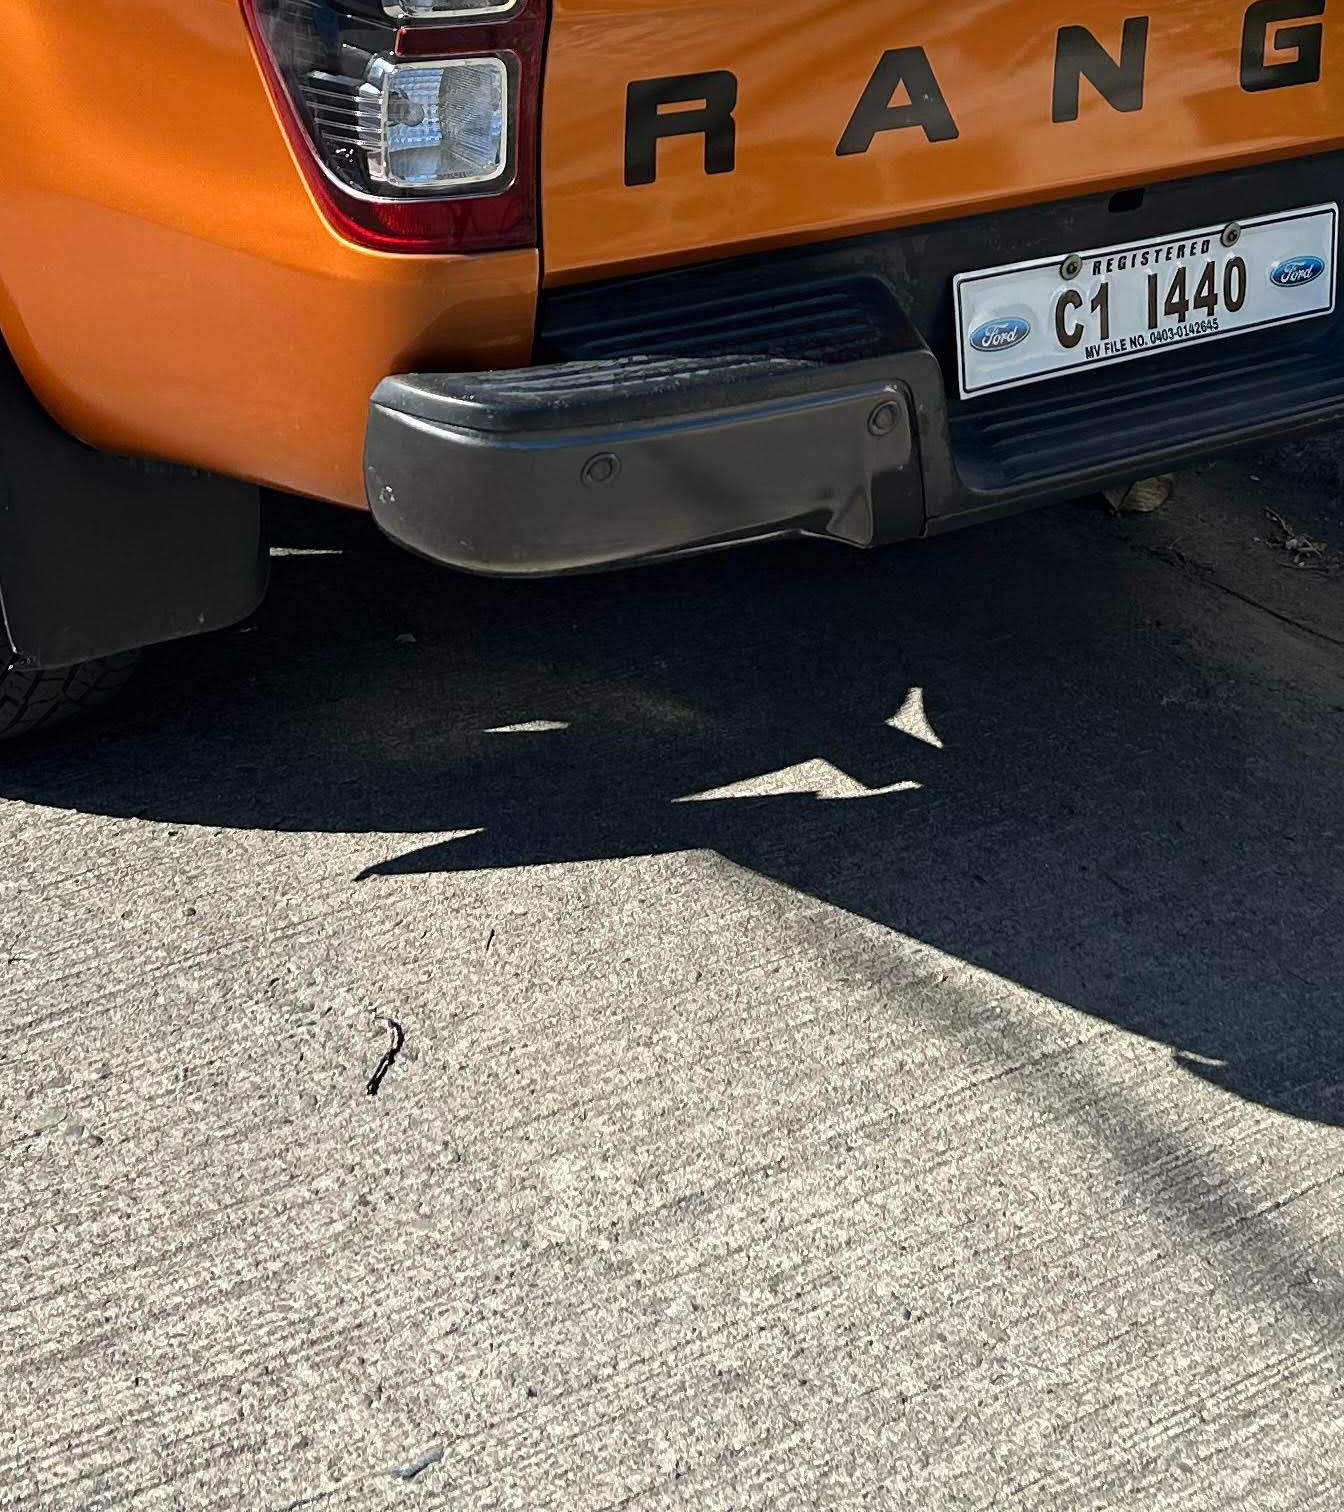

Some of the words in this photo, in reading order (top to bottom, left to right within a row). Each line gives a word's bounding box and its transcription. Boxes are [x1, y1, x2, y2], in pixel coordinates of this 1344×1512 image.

[1092, 239, 1211, 276] REGISTERED
[1054, 281, 1110, 349] C1
[1085, 345, 1101, 359] MV
[1104, 338, 1127, 355] FILE
[1129, 334, 1148, 348] NO.
